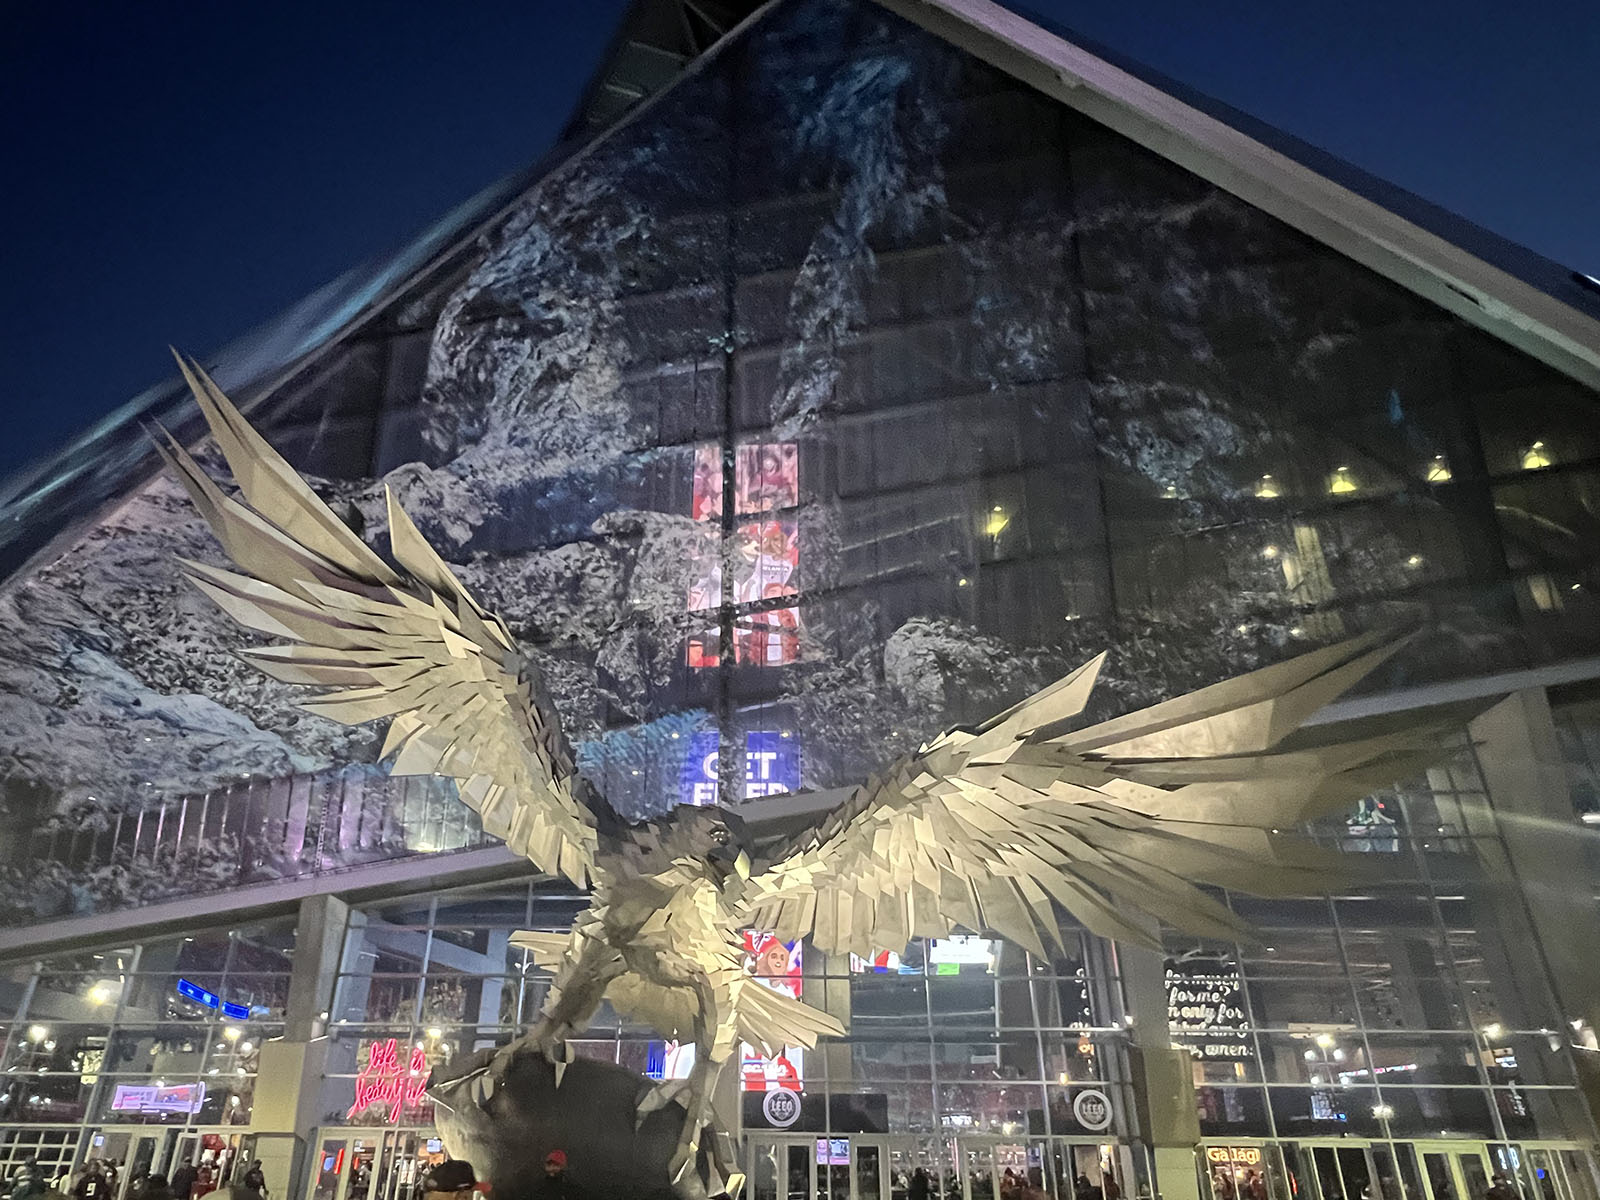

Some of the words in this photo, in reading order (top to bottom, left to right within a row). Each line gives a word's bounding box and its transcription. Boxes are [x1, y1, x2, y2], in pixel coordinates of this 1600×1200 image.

[1169, 986, 1196, 1006] for
[1180, 1004, 1216, 1024] only
[1216, 1003, 1244, 1024] for
